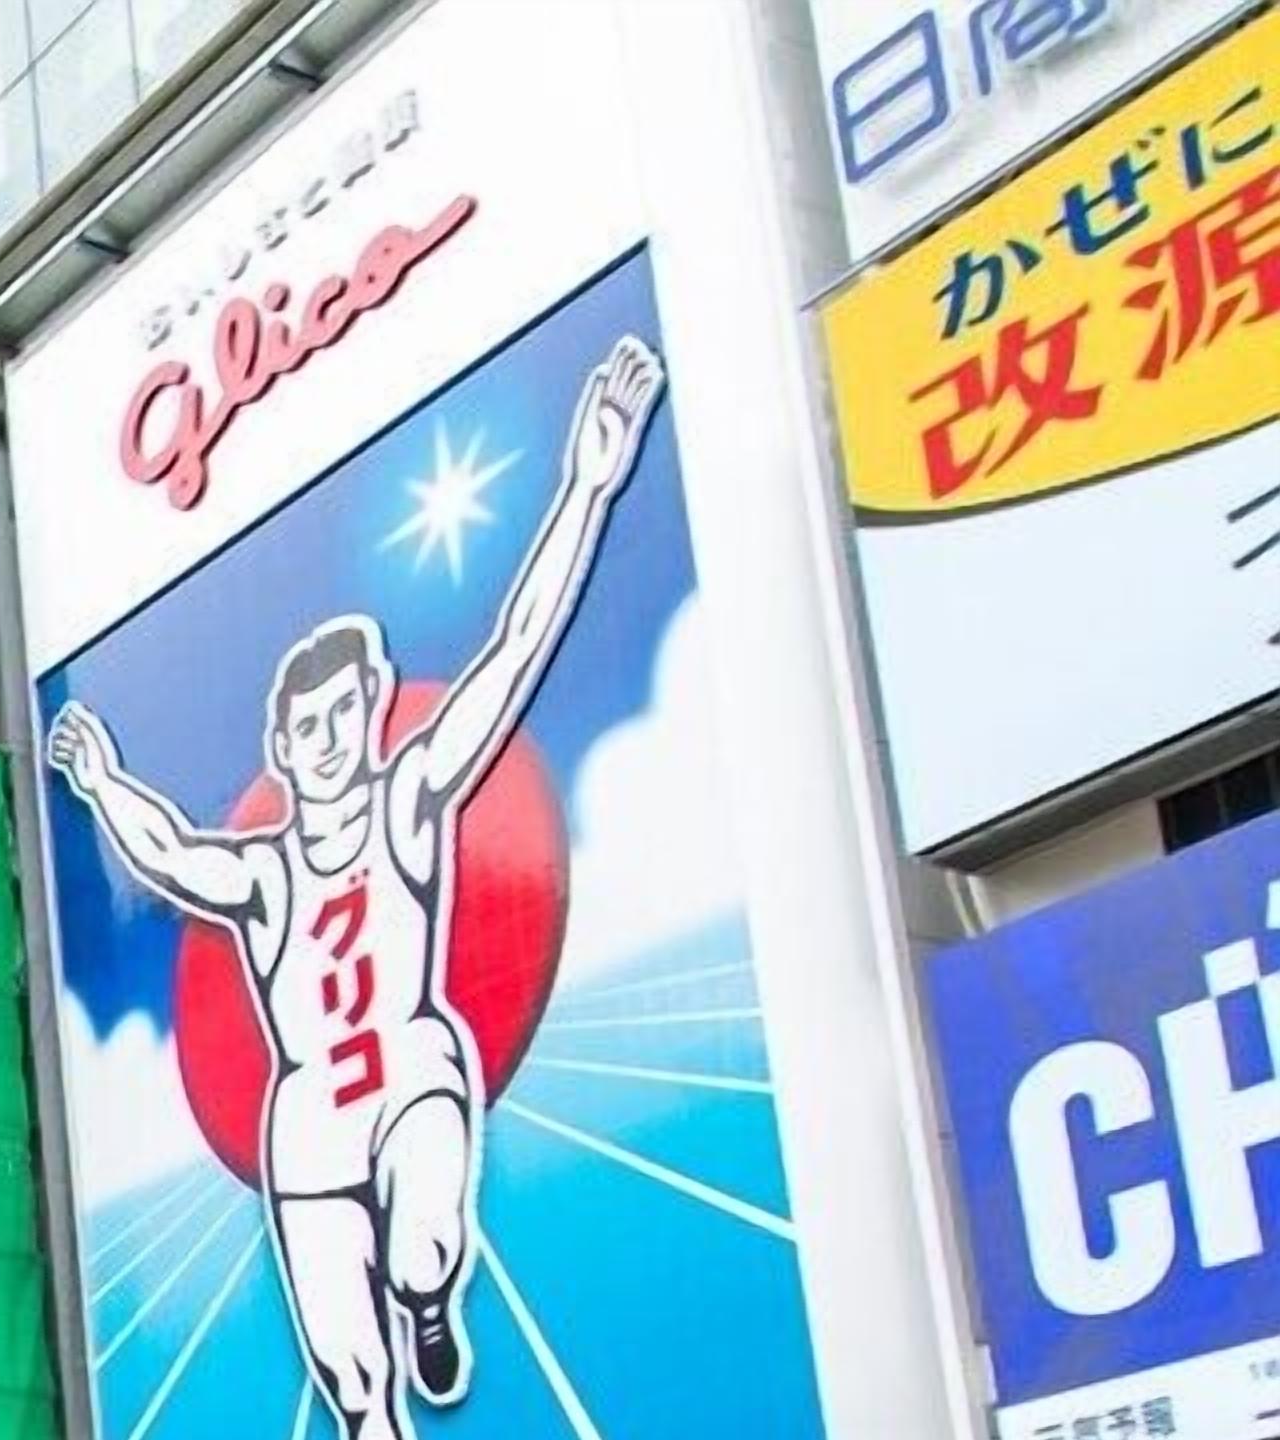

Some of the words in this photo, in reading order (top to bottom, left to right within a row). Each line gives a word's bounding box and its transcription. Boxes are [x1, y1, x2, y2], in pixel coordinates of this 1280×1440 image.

[932, 84, 1279, 340] かぜに
[120, 193, 479, 512] Glico
[310, 867, 385, 1108] グリコ
